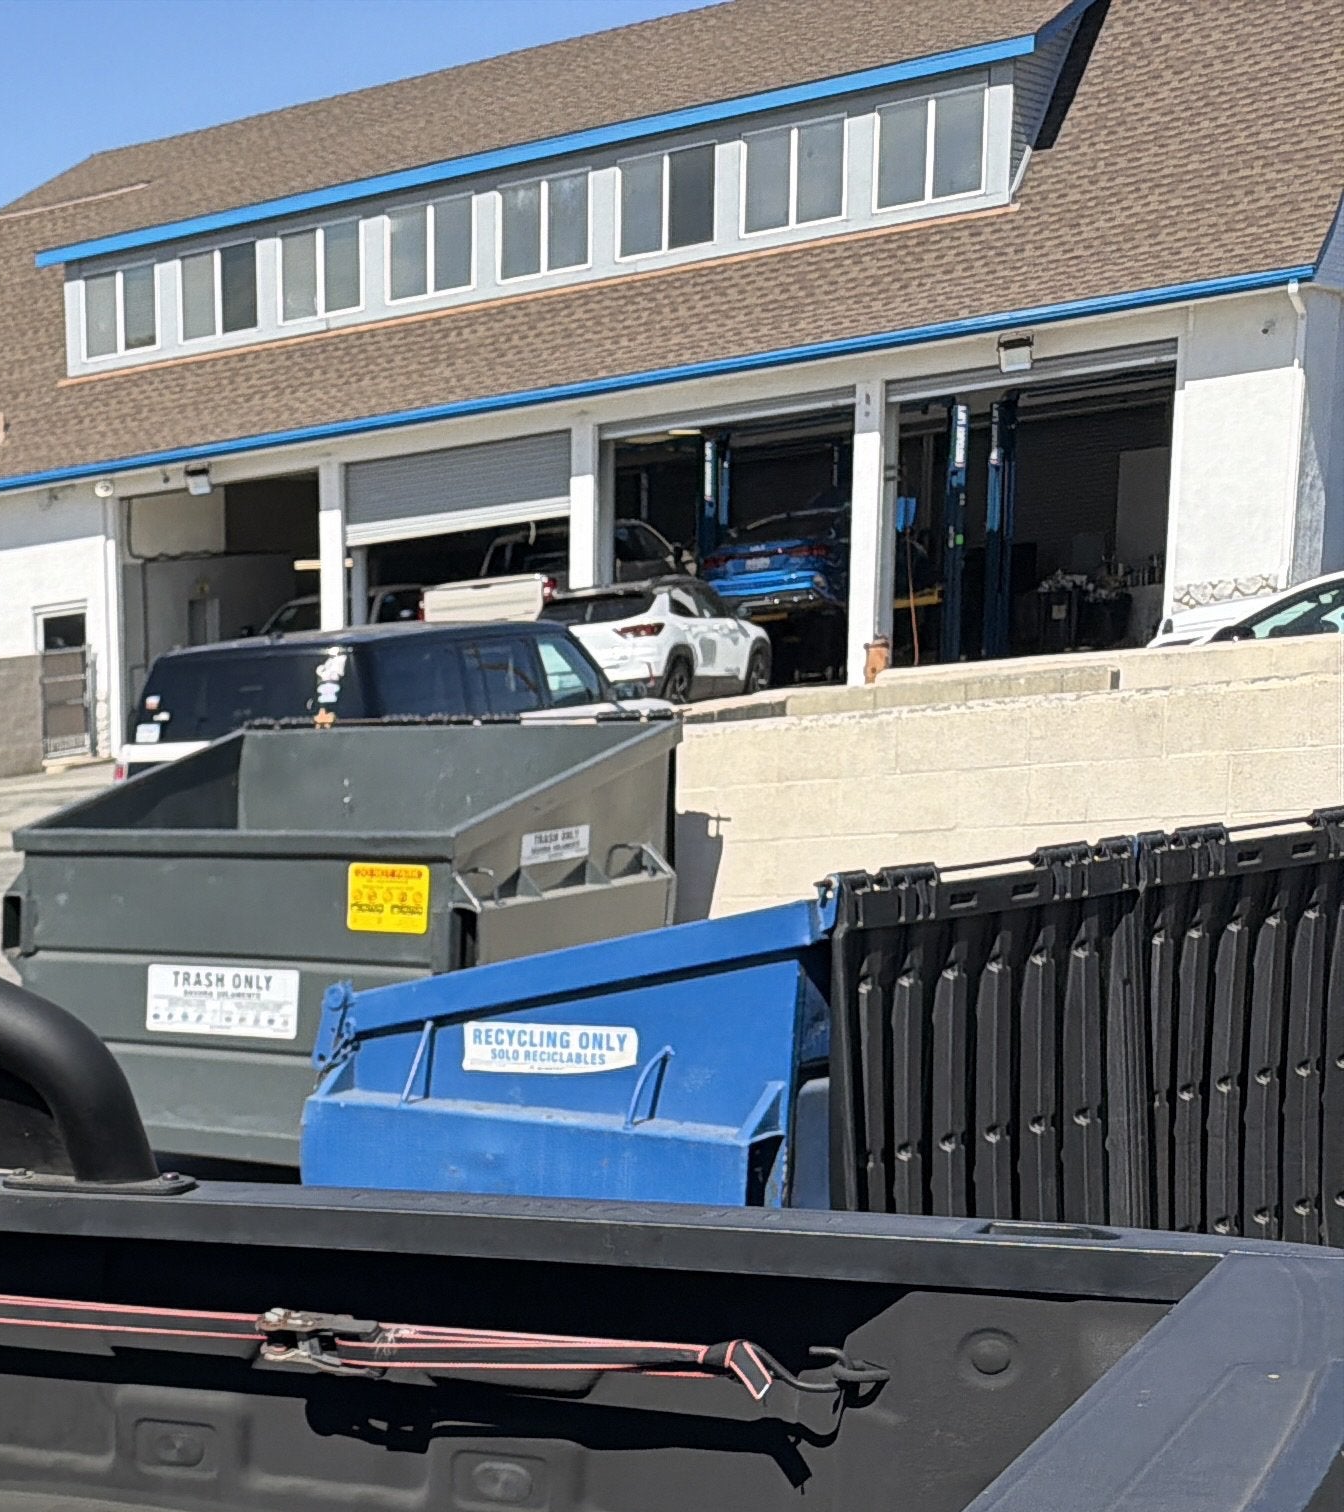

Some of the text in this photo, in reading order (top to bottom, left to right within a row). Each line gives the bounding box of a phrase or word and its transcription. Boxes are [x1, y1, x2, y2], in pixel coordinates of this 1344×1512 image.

[173, 971, 273, 991] TRASH ONLY
[473, 1028, 627, 1052] RECYCLING ONLY
[490, 1048, 606, 1065] SOLO RECICLABLES
